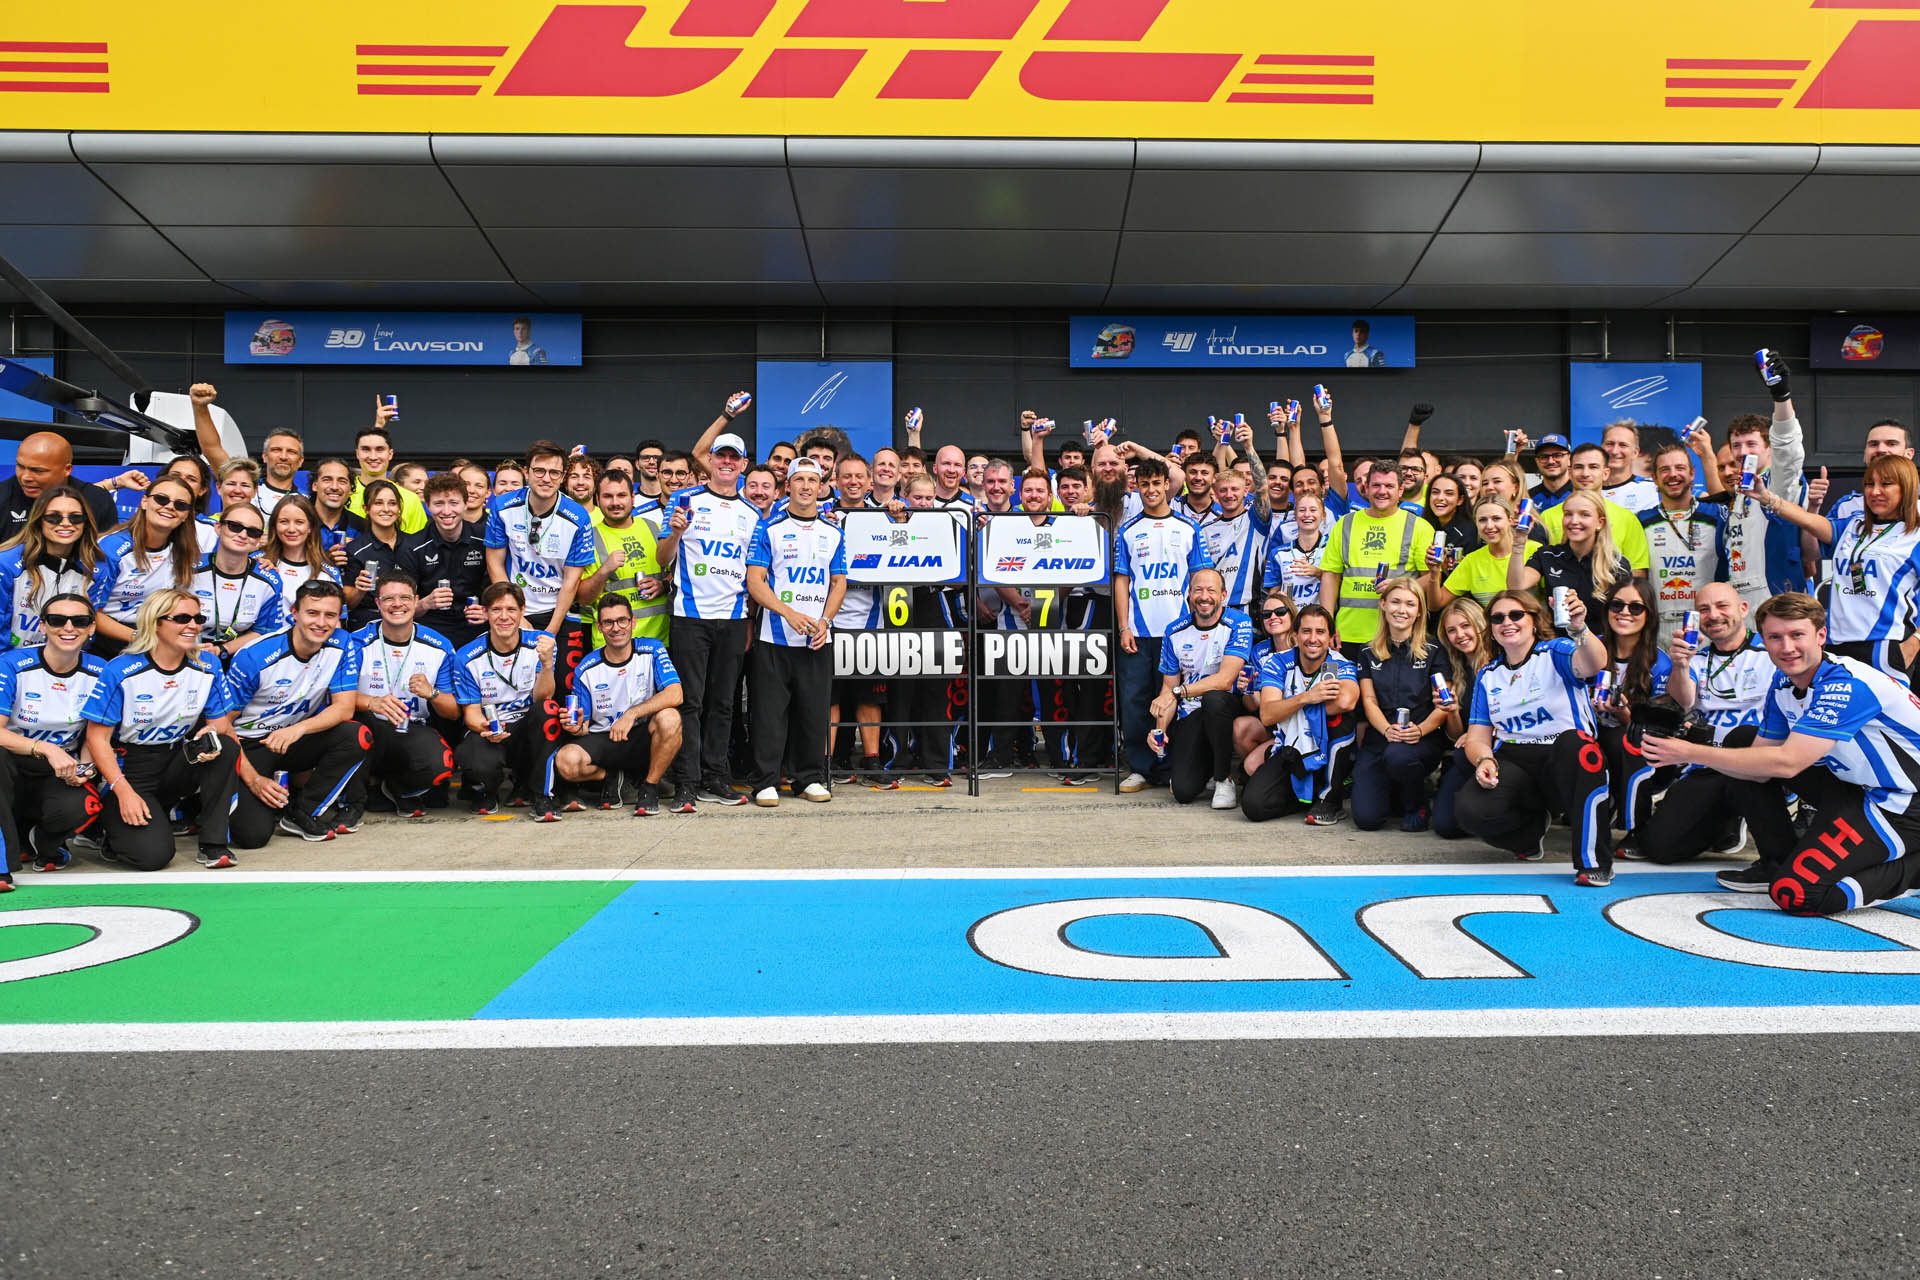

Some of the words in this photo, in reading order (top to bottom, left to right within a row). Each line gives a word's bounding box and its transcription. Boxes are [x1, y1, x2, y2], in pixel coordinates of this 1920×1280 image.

[324, 328, 365, 348] 30
[1162, 332, 1197, 352] 41
[375, 341, 484, 352] LAWSON
[1208, 346, 1327, 355] LINDBLAD
[505, 497, 521, 506] HUGO
[563, 509, 579, 520] HUGO
[696, 539, 742, 559] VISA
[515, 555, 558, 578] VISA
[888, 555, 942, 567] LIAM
[1032, 558, 1095, 569] ARVID
[1660, 556, 1695, 568] VISA
[1733, 561, 1746, 572] Bull
[710, 566, 730, 576] Cash
[730, 570, 742, 579] App
[1140, 562, 1178, 580] VISA
[1225, 566, 1238, 574] App
[1835, 558, 1877, 578] VIA
[260, 569, 279, 585] HUGO
[786, 566, 825, 585] VISA
[1152, 589, 1168, 597] Cash
[1169, 589, 1182, 598] App
[1353, 582, 1377, 592] Airtas
[121, 590, 144, 598] Mobil
[796, 594, 812, 602] Cash
[1660, 591, 1676, 600] Red
[1678, 590, 1696, 600] Bull
[888, 587, 909, 626] 6
[1034, 590, 1055, 626] 7
[18, 614, 40, 632] VI
[1172, 620, 1188, 631] HUGO
[423, 634, 442, 646] HUGO
[466, 645, 483, 658] HUGO
[833, 631, 965, 676] DOUBLE
[984, 633, 1108, 676] POINTS
[17, 658, 34, 667] HUGO
[122, 661, 142, 674] HUGO
[580, 658, 596, 671] HUGO
[873, 684, 887, 693] HU
[1824, 683, 1852, 693] VISA
[1820, 694, 1850, 702] PIRELLI
[18, 714, 38, 723] Mobil
[1496, 706, 1554, 734] VISA
[1807, 711, 1820, 721] Red
[1821, 714, 1838, 725] Bull
[17, 727, 80, 746] VISA
[137, 725, 190, 741] VISA
[1770, 817, 1864, 917] HUG
